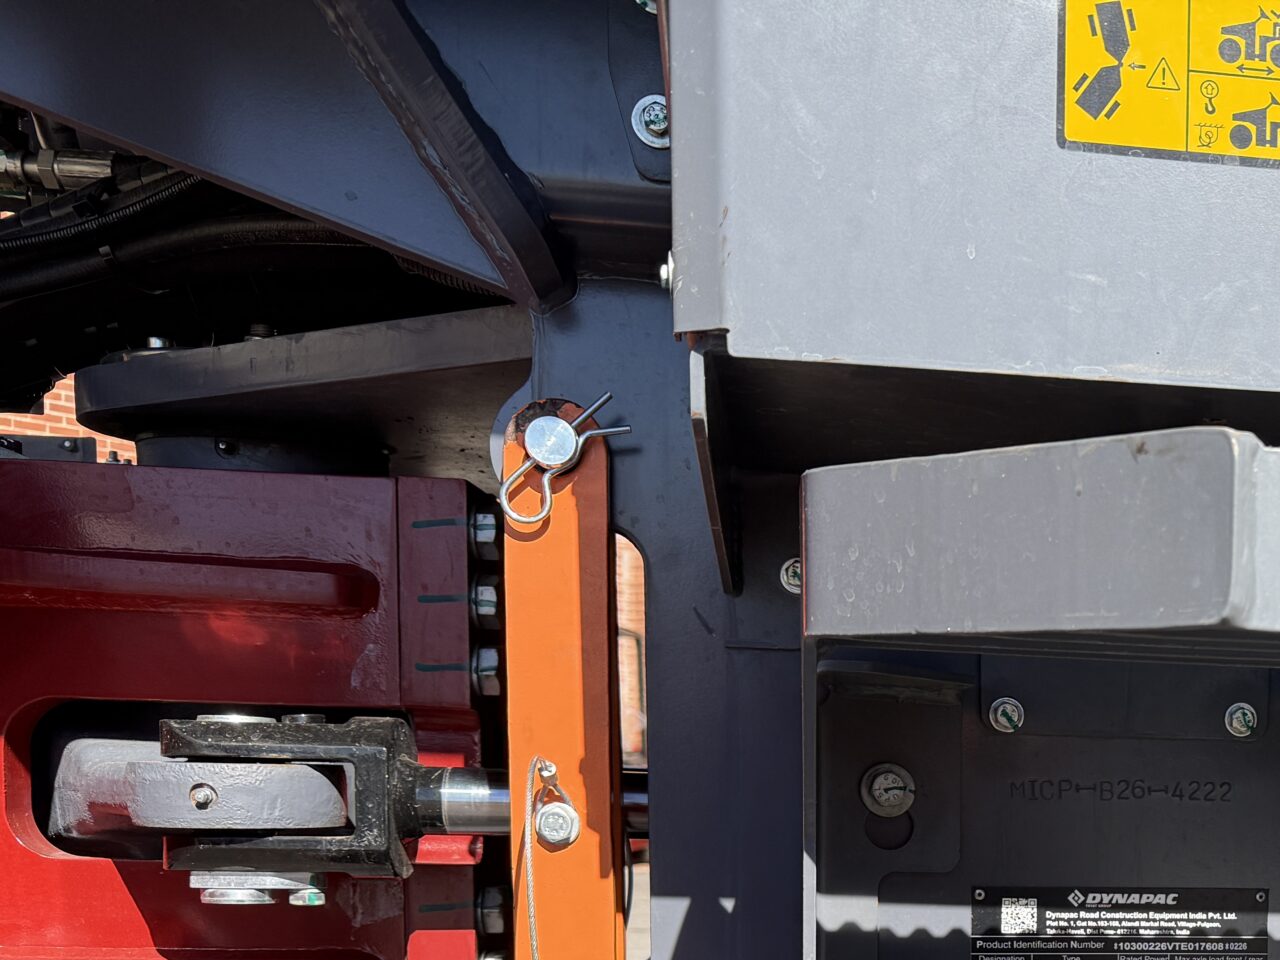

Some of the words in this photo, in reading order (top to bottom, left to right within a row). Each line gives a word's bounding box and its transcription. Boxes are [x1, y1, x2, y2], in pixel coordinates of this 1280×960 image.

[1085, 893, 1179, 905] DYNAPAC
[1045, 911, 1079, 920] Dynapac
[1080, 911, 1100, 919] Road
[1100, 911, 1148, 919] Construction
[1148, 912, 1188, 920] Equipment
[976, 941, 1011, 949] Product
[1013, 941, 1068, 949] Identification
[1070, 941, 1105, 949] Number
